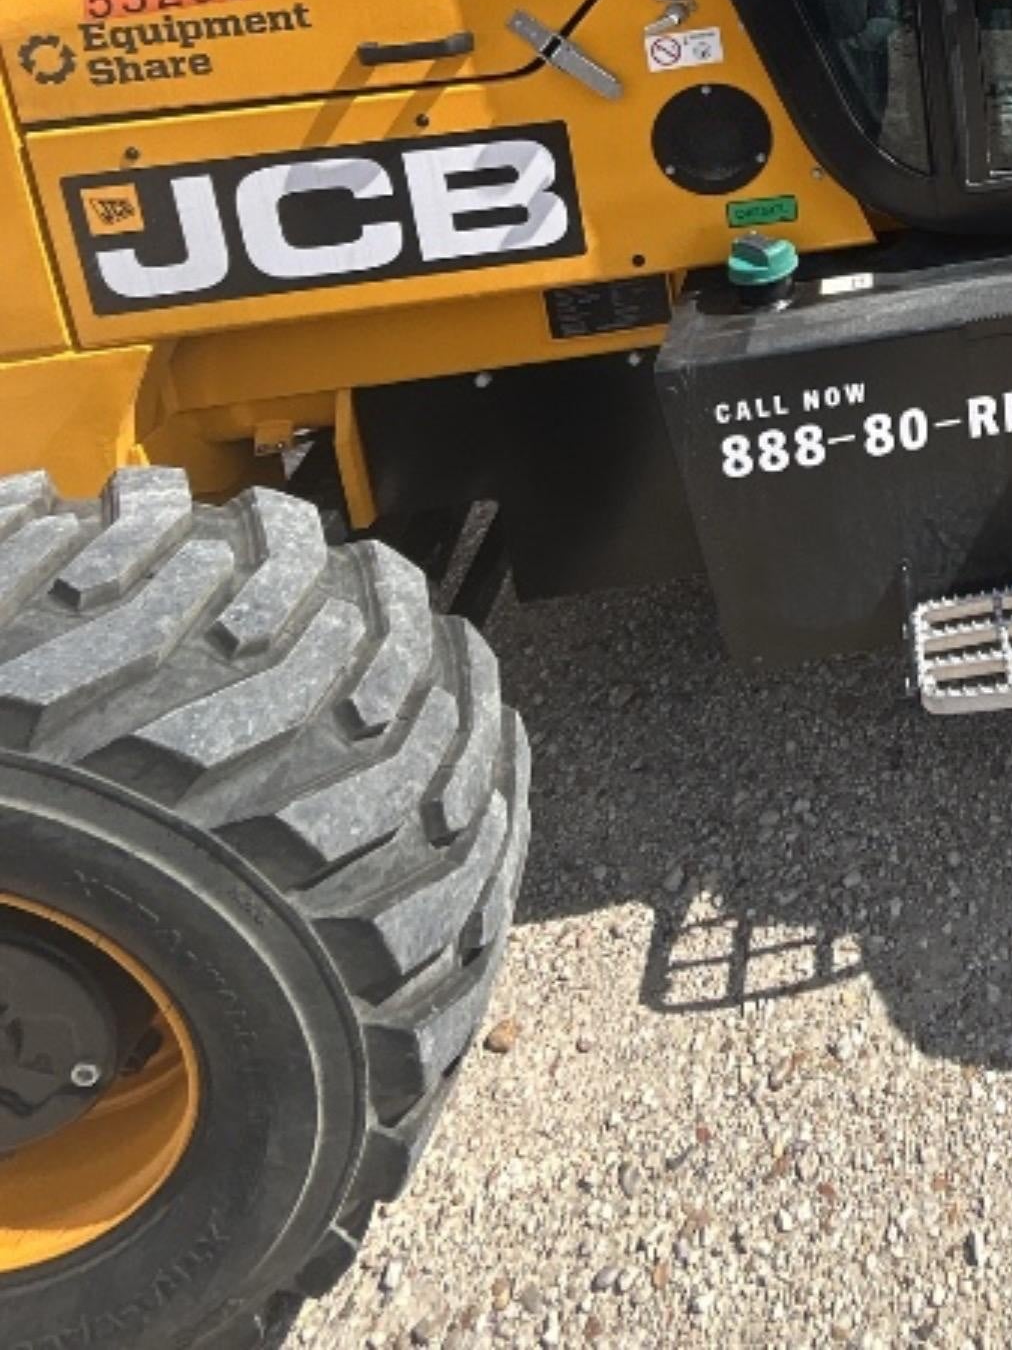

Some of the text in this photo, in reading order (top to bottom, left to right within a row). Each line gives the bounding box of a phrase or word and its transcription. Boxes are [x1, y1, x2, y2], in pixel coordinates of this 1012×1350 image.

[78, 2, 312, 54] Equipment
[85, 52, 213, 87] Share
[95, 139, 568, 299] JCB
[714, 382, 867, 425] CALL NOW
